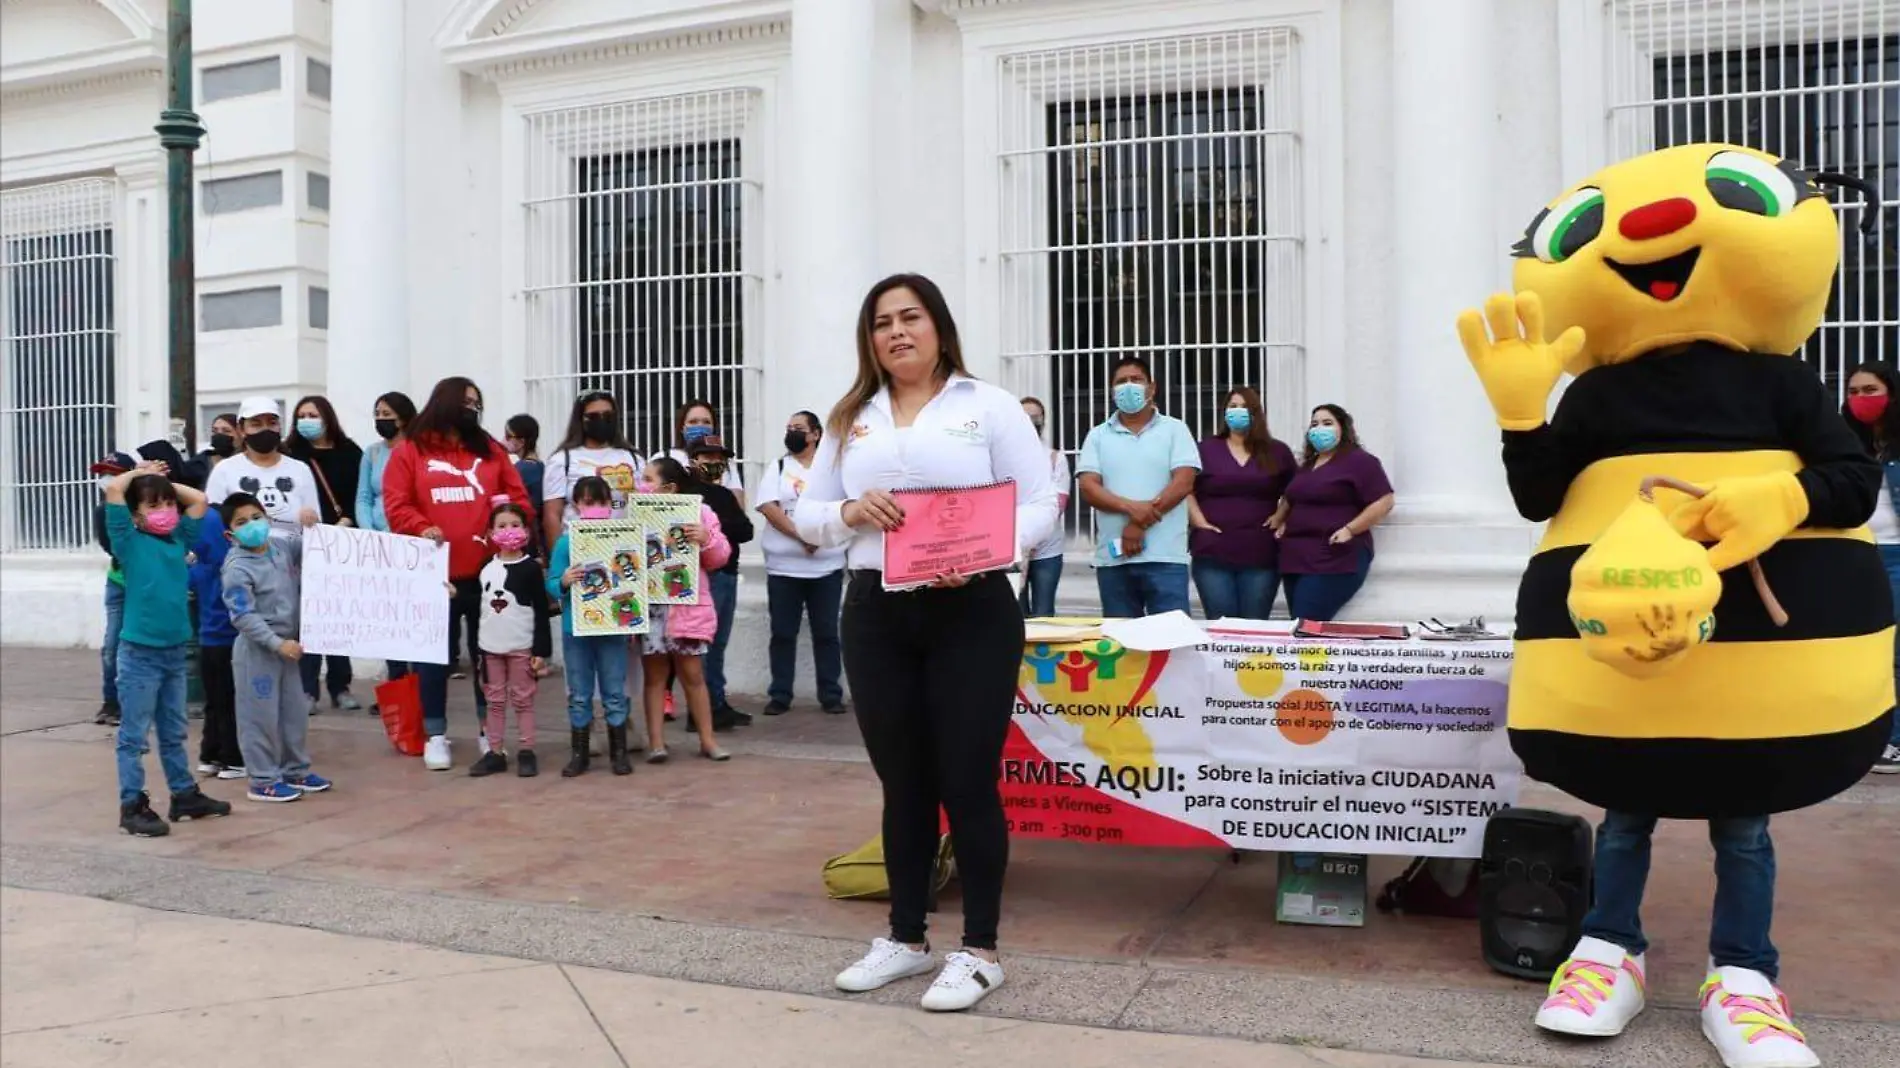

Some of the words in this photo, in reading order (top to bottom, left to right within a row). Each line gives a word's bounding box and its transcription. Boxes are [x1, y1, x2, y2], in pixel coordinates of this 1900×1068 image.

[430, 486, 475, 504] PUMA
[1602, 566, 1702, 589] RESPETO
[1212, 642, 1264, 653] fortaleza
[1267, 646, 1273, 656] y
[1276, 644, 1286, 654] el
[1290, 646, 1320, 655] amor
[1324, 645, 1340, 656] de
[1343, 647, 1394, 657] nuestras
[1398, 647, 1445, 658] familias
[1452, 650, 1460, 660] y
[1224, 659, 1254, 671] hijos,
[1258, 661, 1296, 671] somos
[1299, 661, 1309, 671] la
[1313, 661, 1334, 672] raiz
[1338, 663, 1344, 674] y
[1347, 661, 1358, 672] la
[1361, 663, 1423, 674] verdadera
[1427, 663, 1466, 675] fuerza
[1468, 664, 1484, 675] de
[1301, 678, 1347, 689] nuestra
[1350, 679, 1403, 690] NACION!
[1012, 702, 1110, 717] DUCACION
[1117, 704, 1185, 719] INICIAL
[1205, 697, 1264, 711] Propuesta
[1267, 699, 1300, 710] social
[1303, 700, 1341, 712] JUSTA
[1345, 702, 1353, 712] Y
[1355, 702, 1418, 716] LEGITIMA,
[1422, 703, 1432, 714] la
[1435, 703, 1491, 716] hacemos
[1202, 715, 1226, 726] para
[1229, 716, 1267, 726] contar
[1270, 717, 1292, 727] con
[1294, 717, 1305, 728] el
[1309, 719, 1345, 731] apoyo
[1349, 719, 1364, 729] de
[1367, 719, 1423, 731] Gobierno
[1425, 721, 1433, 734] y
[1436, 721, 1494, 732] sociedad!
[1003, 758, 1087, 788] RMES
[1095, 764, 1185, 799] AQUI:
[1197, 764, 1252, 783] Sobre
[1257, 767, 1273, 785] la
[1279, 769, 1365, 786] iniciativa
[1371, 771, 1496, 790] CIUDADANA
[1001, 795, 1037, 809] unes
[1042, 796, 1051, 810] a
[1053, 794, 1112, 814] Viernes
[1185, 794, 1225, 813] para
[1230, 796, 1318, 813] construir
[1323, 795, 1340, 813] el
[1346, 799, 1406, 815] nuevo
[1019, 820, 1044, 833] am
[1060, 821, 1091, 838] 3:00
[1096, 825, 1123, 840] pm
[1222, 820, 1247, 837] DE
[1253, 821, 1369, 841] EDUCACION
[1375, 824, 1467, 844] INICIAL!”
